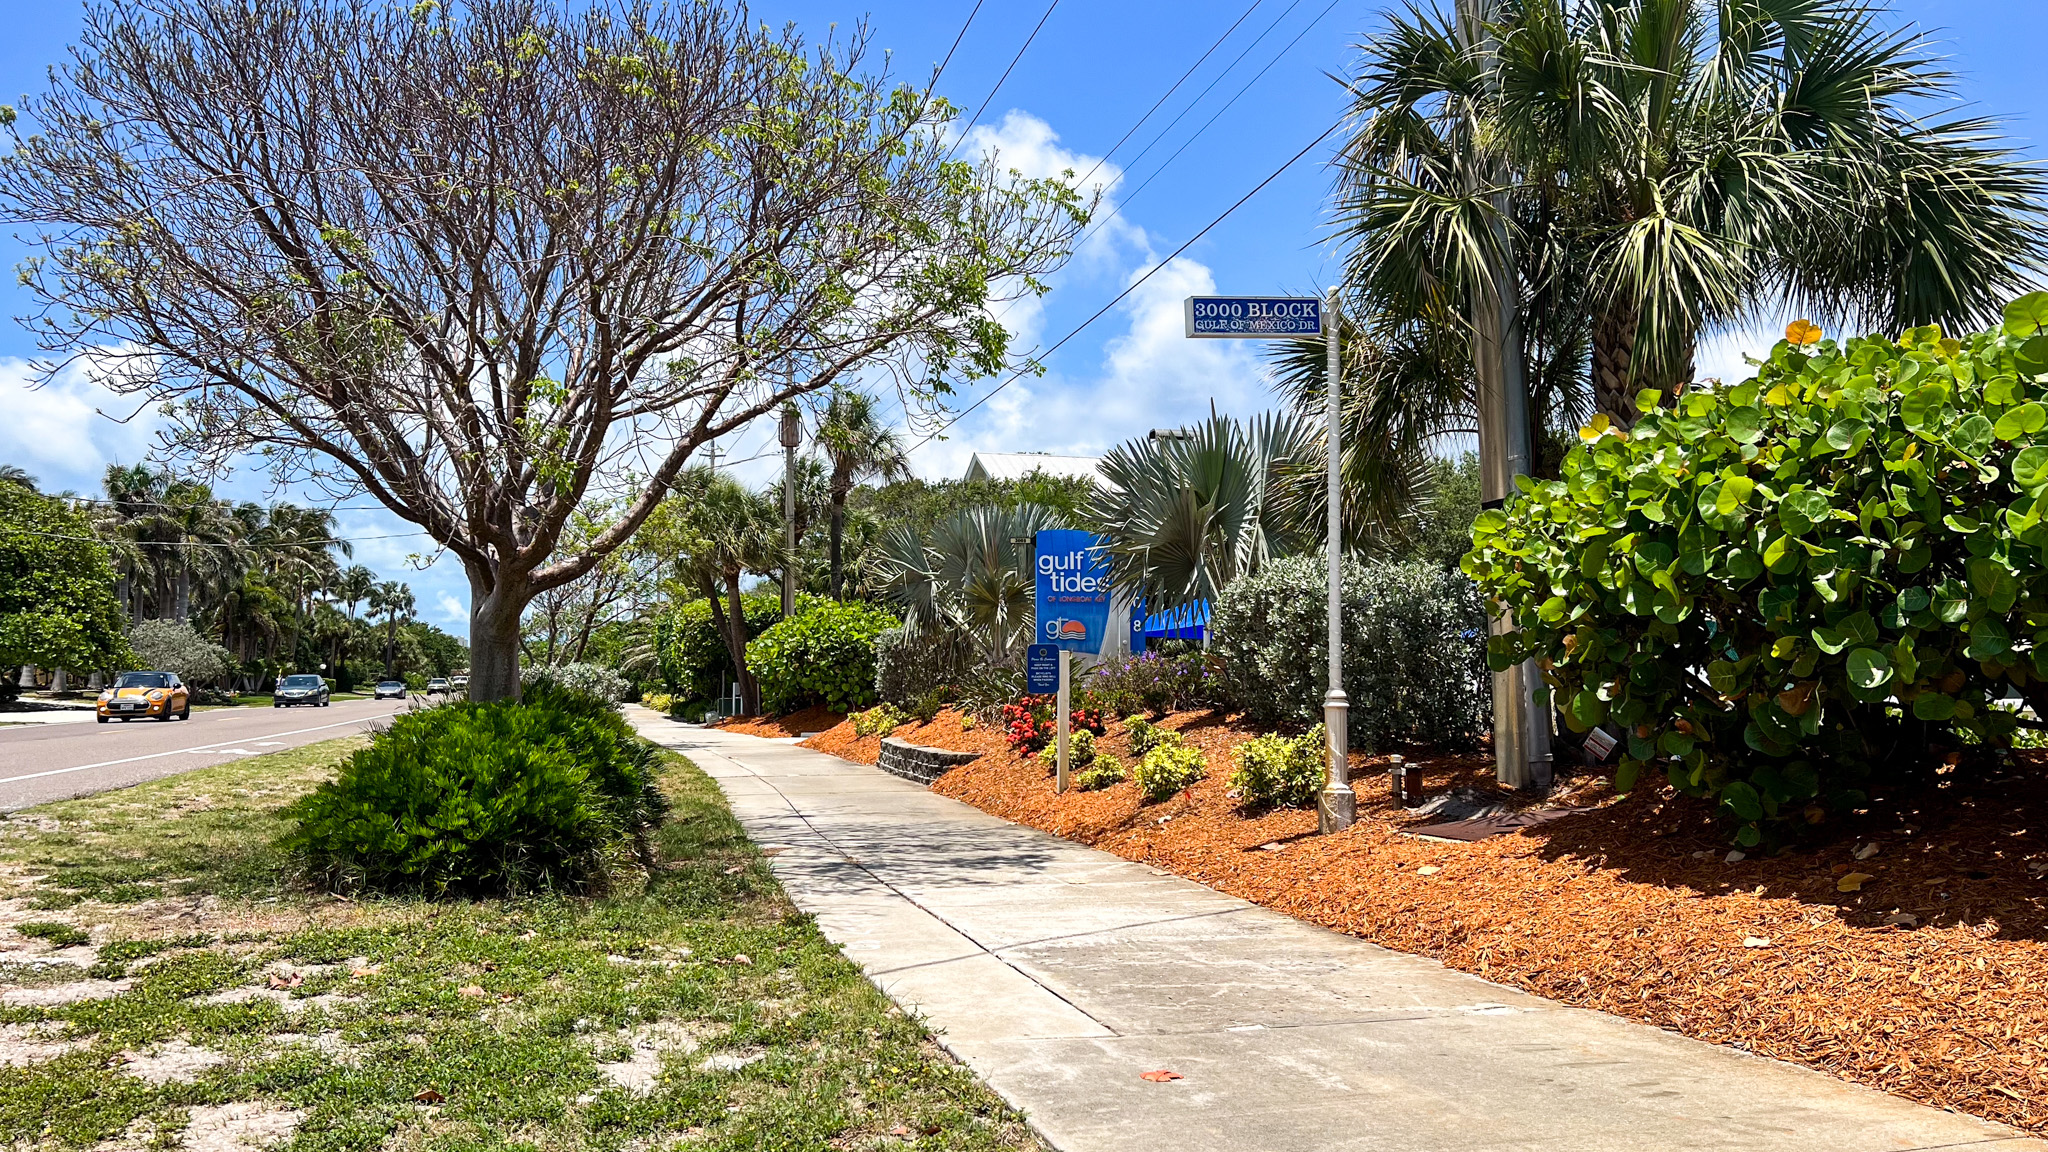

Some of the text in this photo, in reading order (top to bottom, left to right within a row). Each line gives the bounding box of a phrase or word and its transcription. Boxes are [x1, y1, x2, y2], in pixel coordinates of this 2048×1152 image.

[1195, 302, 1317, 318] 3000 BLOCK
[1195, 319, 1318, 330] GULF OF MEXICO DR.
[1038, 551, 1084, 575] gulf
[1050, 571, 1110, 593] tides
